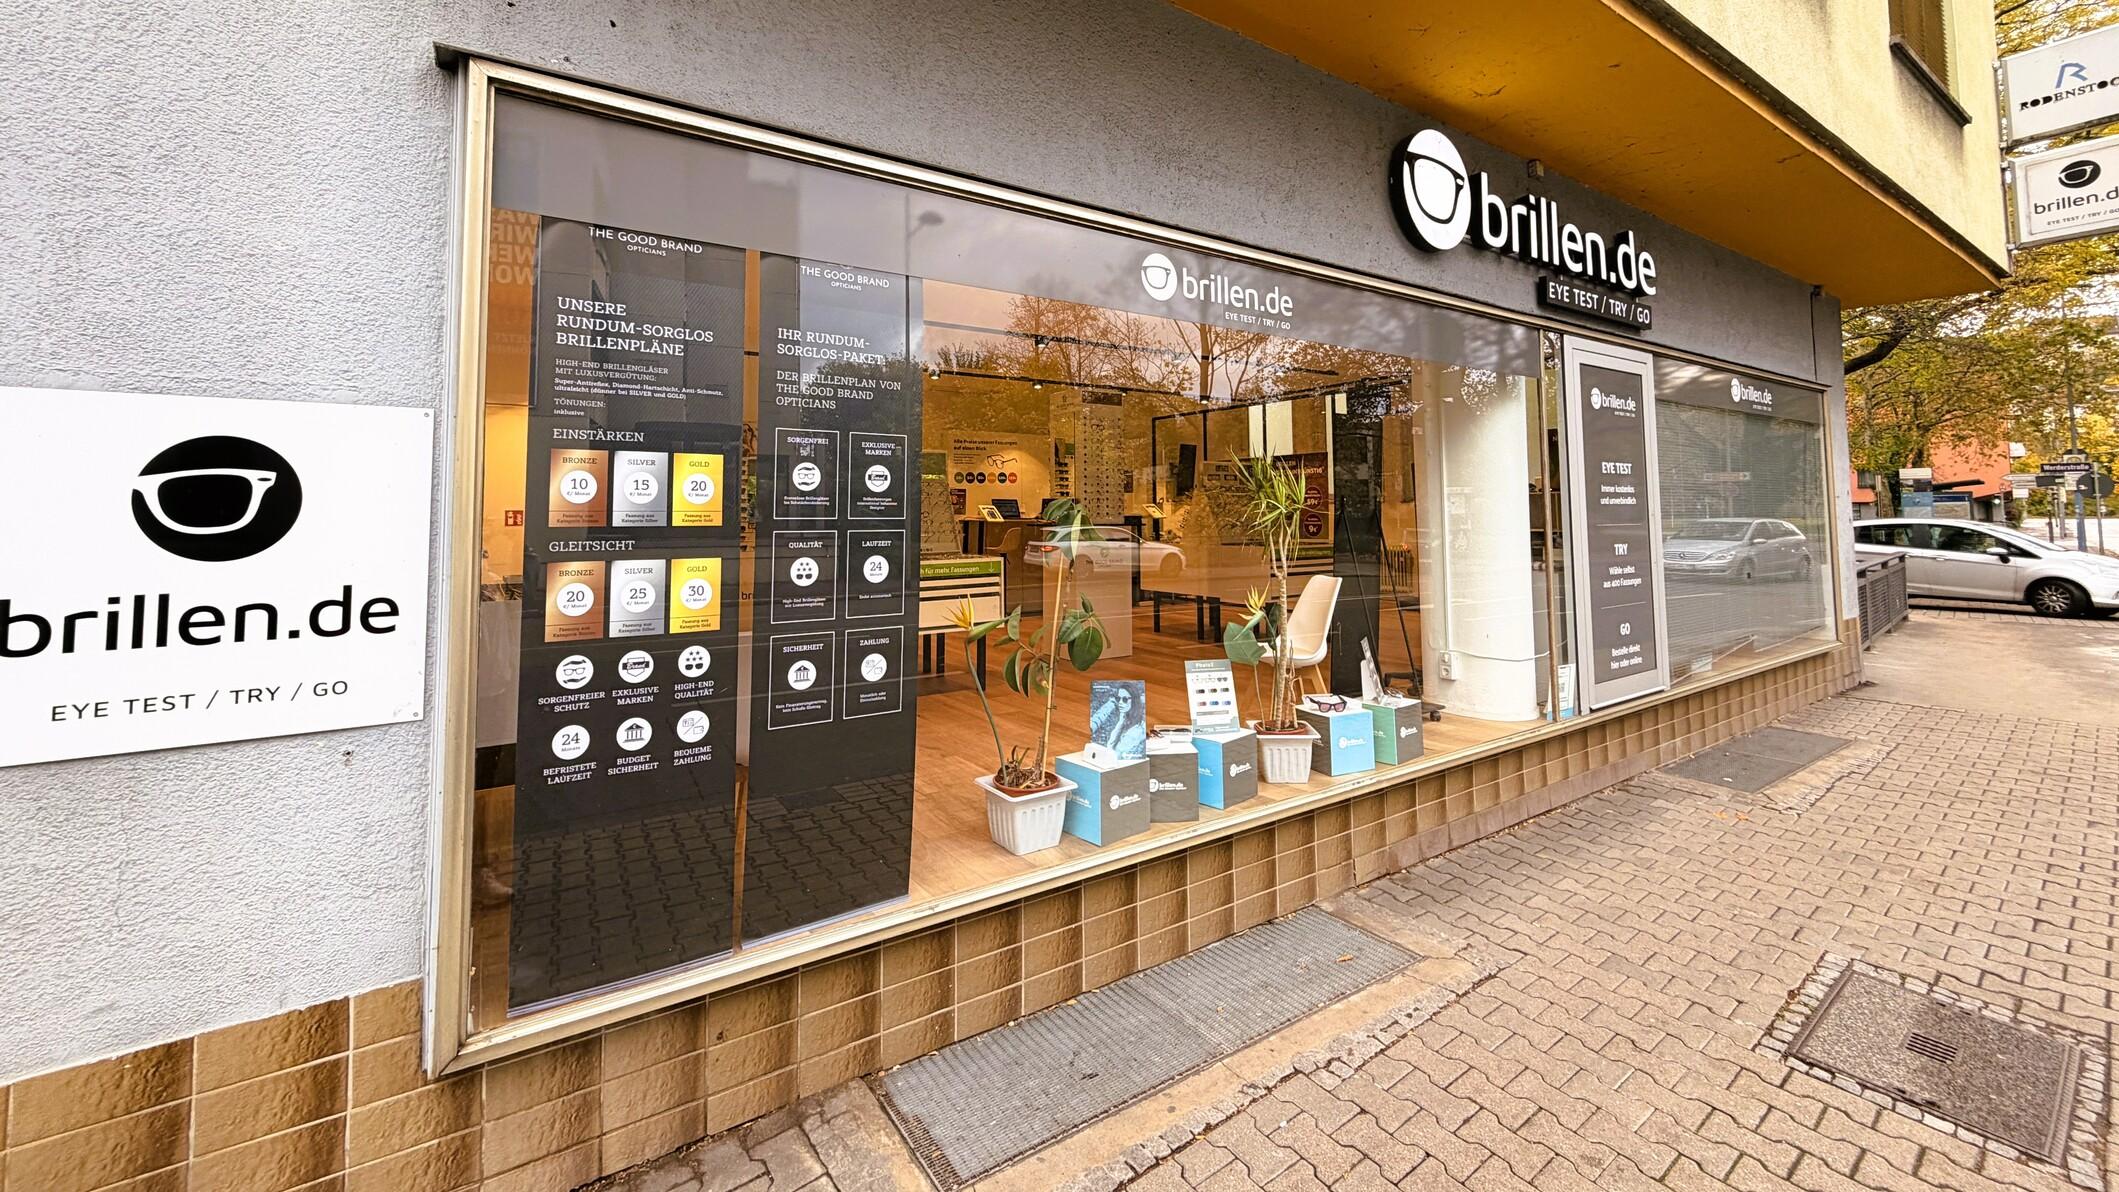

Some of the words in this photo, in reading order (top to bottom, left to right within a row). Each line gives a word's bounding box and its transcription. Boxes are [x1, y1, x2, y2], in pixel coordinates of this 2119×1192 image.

[1480, 171, 1656, 296] brillen.de
[589, 226, 614, 240] THE
[618, 232, 657, 246] GOOD
[661, 239, 703, 254] BRAND
[627, 245, 666, 256] OPTICIANS
[801, 265, 821, 277] THE
[824, 270, 854, 282] GOOD
[858, 275, 889, 288] BRAND
[831, 282, 862, 291] OPTICIANS
[1182, 267, 1293, 317] brillen.de
[557, 297, 626, 316] UNSERE
[1549, 281, 1570, 301] EYE
[1572, 288, 1599, 309] TEST
[1608, 299, 1628, 318] TRY
[1636, 307, 1650, 324] GO
[1225, 311, 1238, 321] EYE
[1239, 314, 1256, 325] TEST
[1262, 318, 1274, 327] TRY
[1281, 321, 1291, 330] GO
[557, 314, 714, 342] RUNDUM-SORGLOS
[777, 328, 802, 341] IHR
[807, 332, 869, 348] RUNDUM-
[556, 333, 684, 356] BRILLENPLÄNE
[556, 359, 600, 369] HIGH-END
[603, 363, 668, 375] BRILLENGLÄSER
[555, 367, 572, 375] MIT
[575, 370, 657, 381] LUXUSVERGÜTUNG:
[777, 371, 798, 381] DER
[802, 373, 876, 388] BRILLENPLAN
[879, 380, 901, 391] VON
[776, 383, 799, 394] THE
[803, 386, 834, 397] GOOD
[837, 389, 873, 399] BRAND
[1741, 384, 1772, 404] brillen.de
[554, 398, 606, 408] TÖNUNGEN:
[776, 397, 836, 409] OPTICIANS
[1602, 393, 1636, 411] brillen.de
[553, 429, 644, 442] EINSTÄRKEN
[787, 436, 829, 445] SORGENFREI
[562, 457, 598, 465] BRONZE
[1602, 462, 1616, 474] EYE
[1616, 463, 1632, 474] TEST
[571, 478, 588, 490] 10
[633, 479, 649, 491] 15
[691, 481, 707, 492] 20
[549, 540, 635, 552] GLEITSICHT
[1614, 543, 1628, 555] TRY
[870, 562, 882, 571] 24
[559, 569, 594, 577] BRONZE
[567, 591, 585, 602] 20
[630, 588, 647, 599] 25
[688, 585, 704, 596] 30
[0, 585, 399, 658] brillen.de
[1620, 623, 1630, 635] GO
[860, 638, 890, 646] ZAHLUNG
[783, 644, 824, 653] SICHERHEIT
[612, 686, 659, 697] EXKLUSIVE
[674, 681, 714, 691] HIGH-END
[538, 691, 605, 705] SORGENFREIER
[674, 688, 714, 699] QUALITÄT
[51, 701, 109, 722] EYE
[123, 694, 195, 715] TEST
[230, 686, 281, 705] TRY
[313, 680, 348, 697] GO
[617, 695, 654, 706] MARKEN
[554, 702, 590, 712] SCHUTZ
[562, 732, 580, 746] 24
[674, 746, 712, 757] BEQUEME
[617, 755, 652, 765] BUDGET
[673, 753, 712, 766] ZAHLUNG
[543, 762, 597, 776] BEFRISTETE
[608, 762, 659, 776] SICHERHEIT
[548, 771, 592, 785] LAUFZEIT
